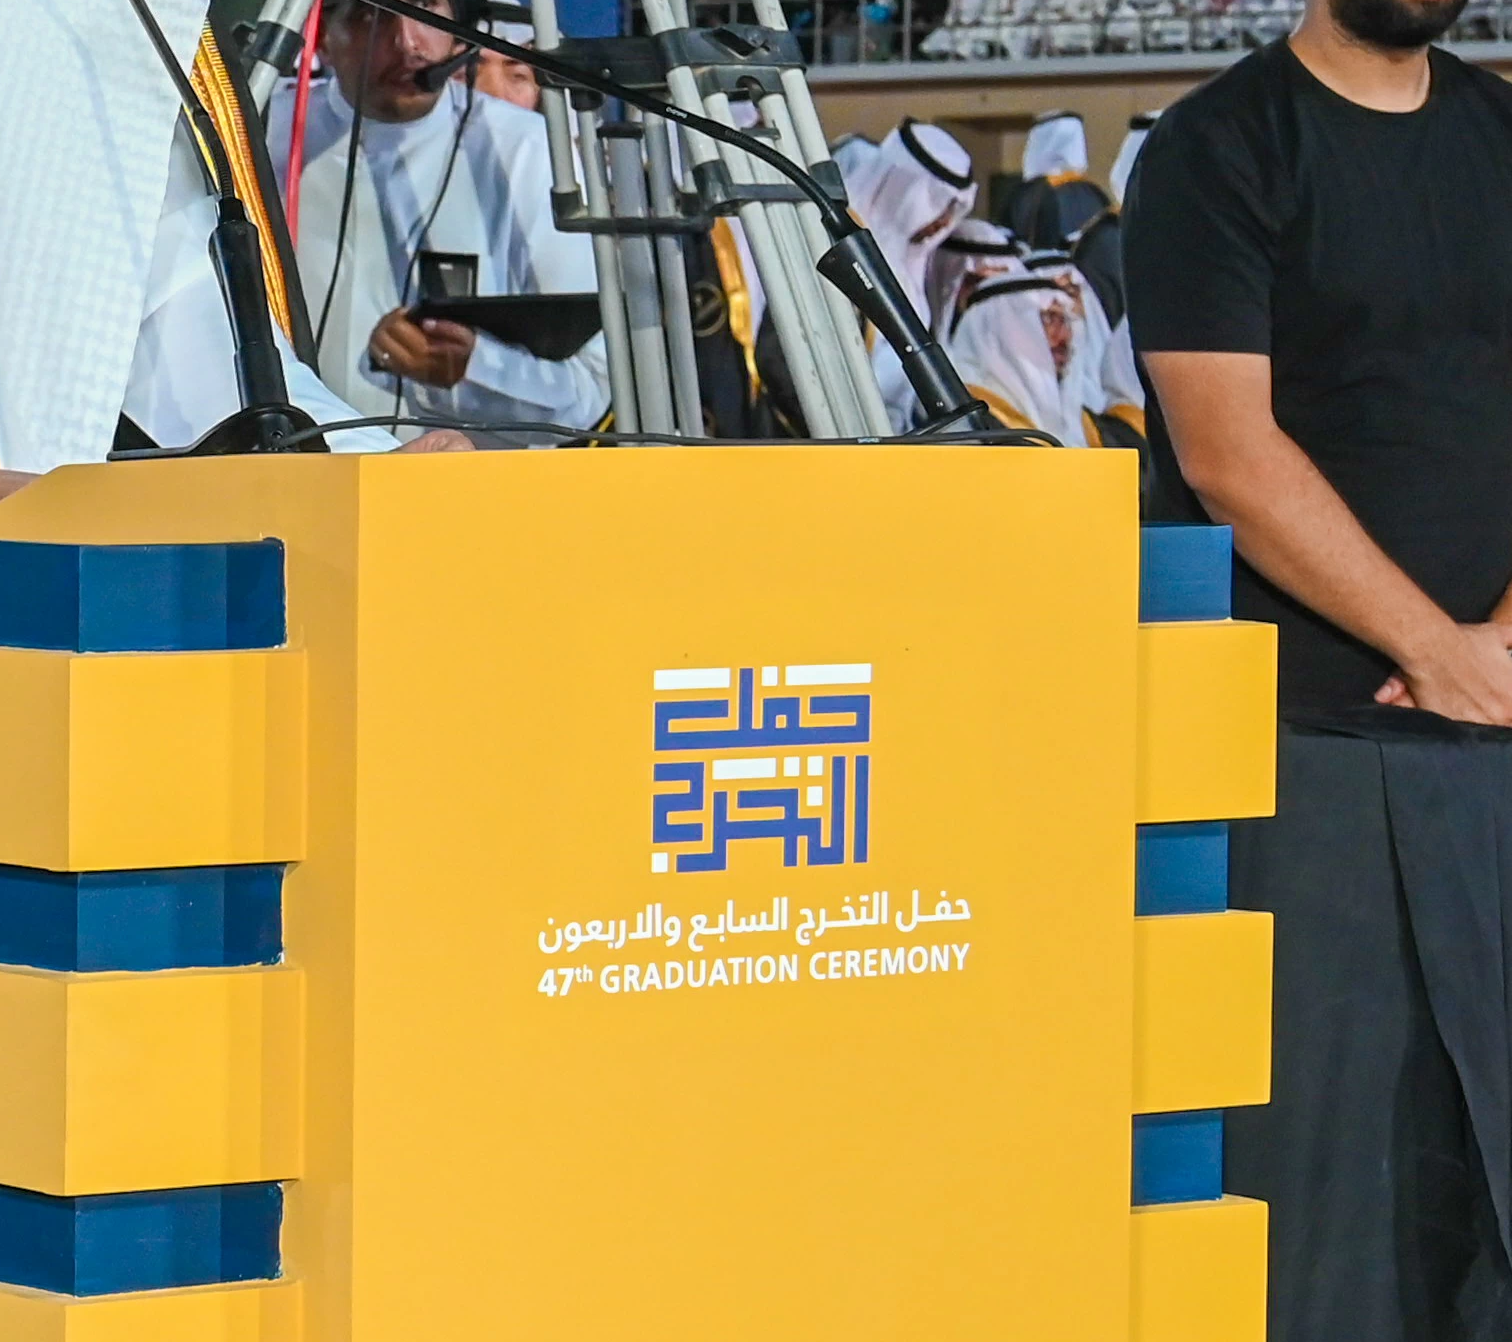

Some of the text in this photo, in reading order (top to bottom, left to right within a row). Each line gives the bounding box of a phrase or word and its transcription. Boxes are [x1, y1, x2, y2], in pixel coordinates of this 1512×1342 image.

[687, 896, 789, 953] السابع
[795, 890, 890, 946] التخرج
[895, 889, 972, 933] حفل
[600, 954, 799, 994] GRADUATION
[809, 942, 971, 980] CEREMONY
